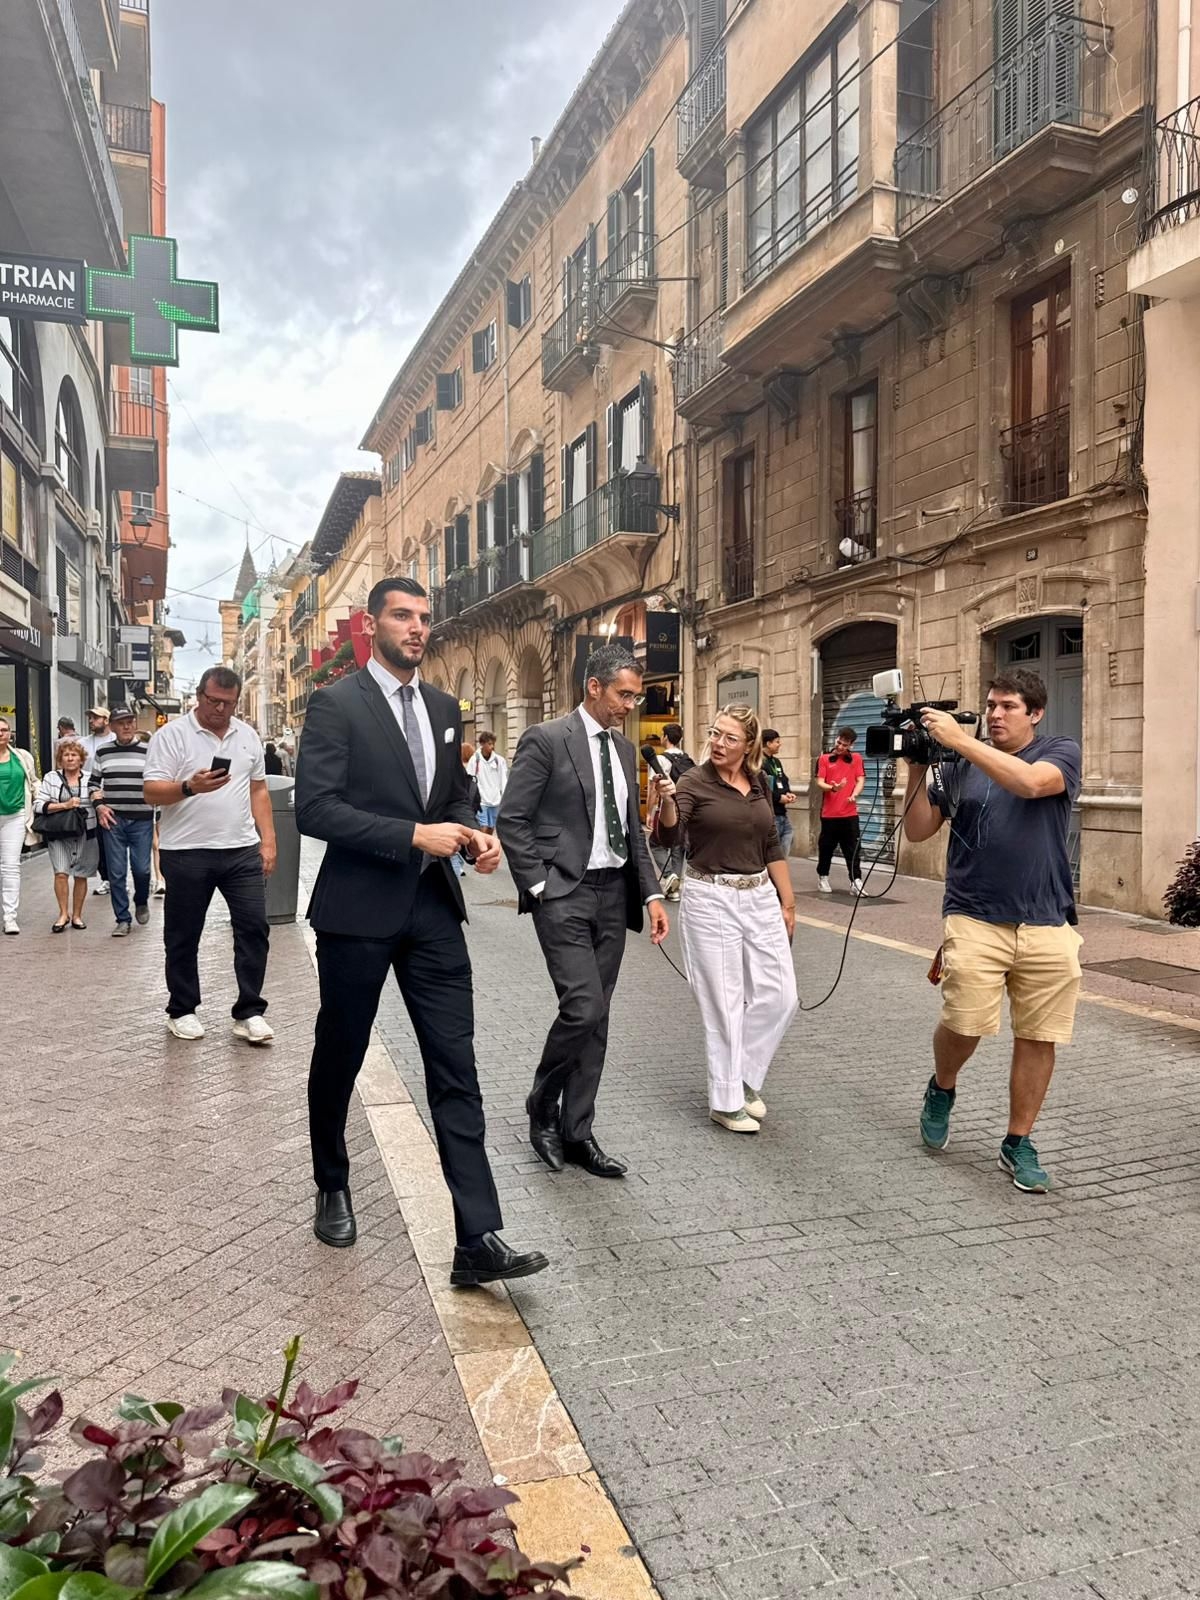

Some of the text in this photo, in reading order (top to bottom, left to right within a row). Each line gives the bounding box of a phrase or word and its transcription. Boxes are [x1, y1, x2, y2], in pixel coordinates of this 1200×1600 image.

[0, 263, 75, 292] TRIAN
[2, 291, 75, 309] PHARMACIE
[933, 767, 945, 792] SONY
